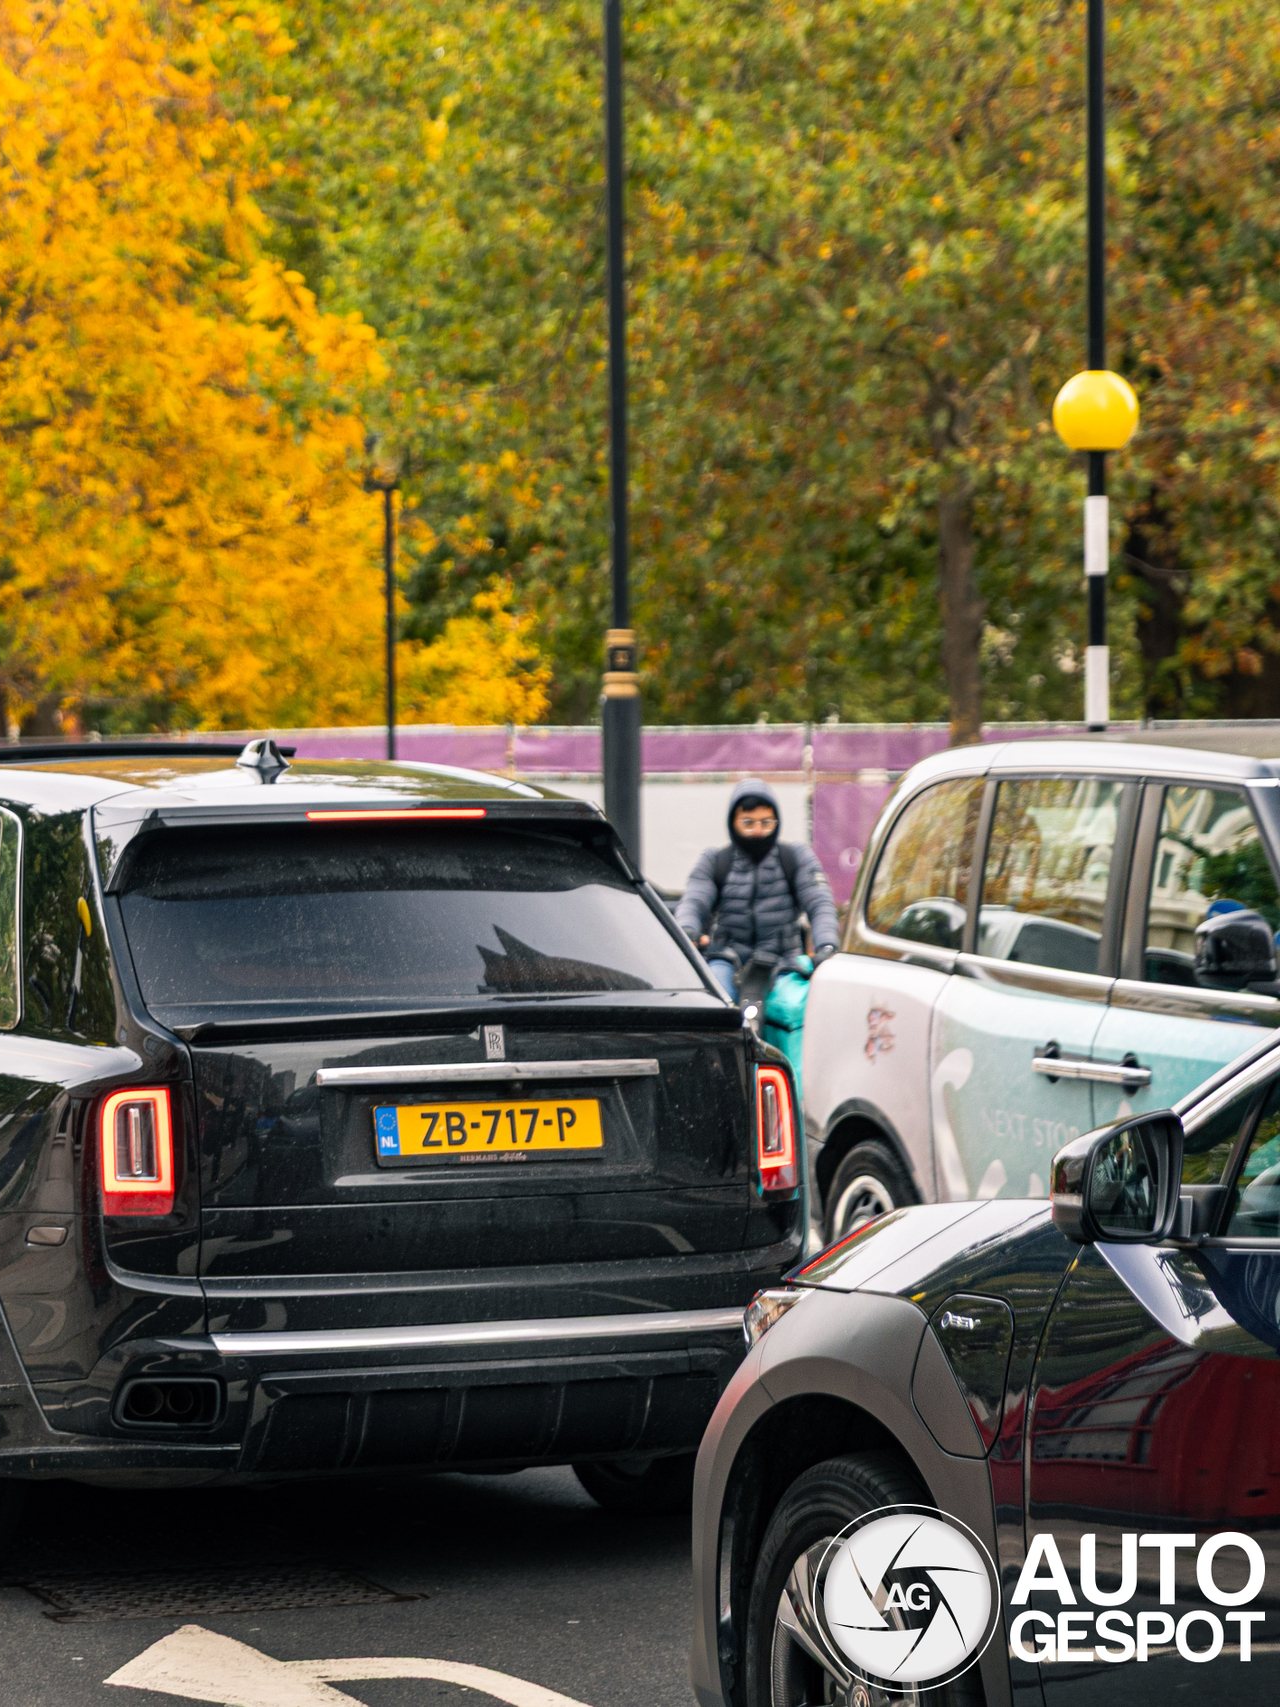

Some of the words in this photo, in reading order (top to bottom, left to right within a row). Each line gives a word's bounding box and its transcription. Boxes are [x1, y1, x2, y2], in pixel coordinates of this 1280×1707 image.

[420, 1106, 578, 1147] ZB-717-P
[980, 1107, 1027, 1141] NEXT
[381, 1136, 398, 1149] NL
